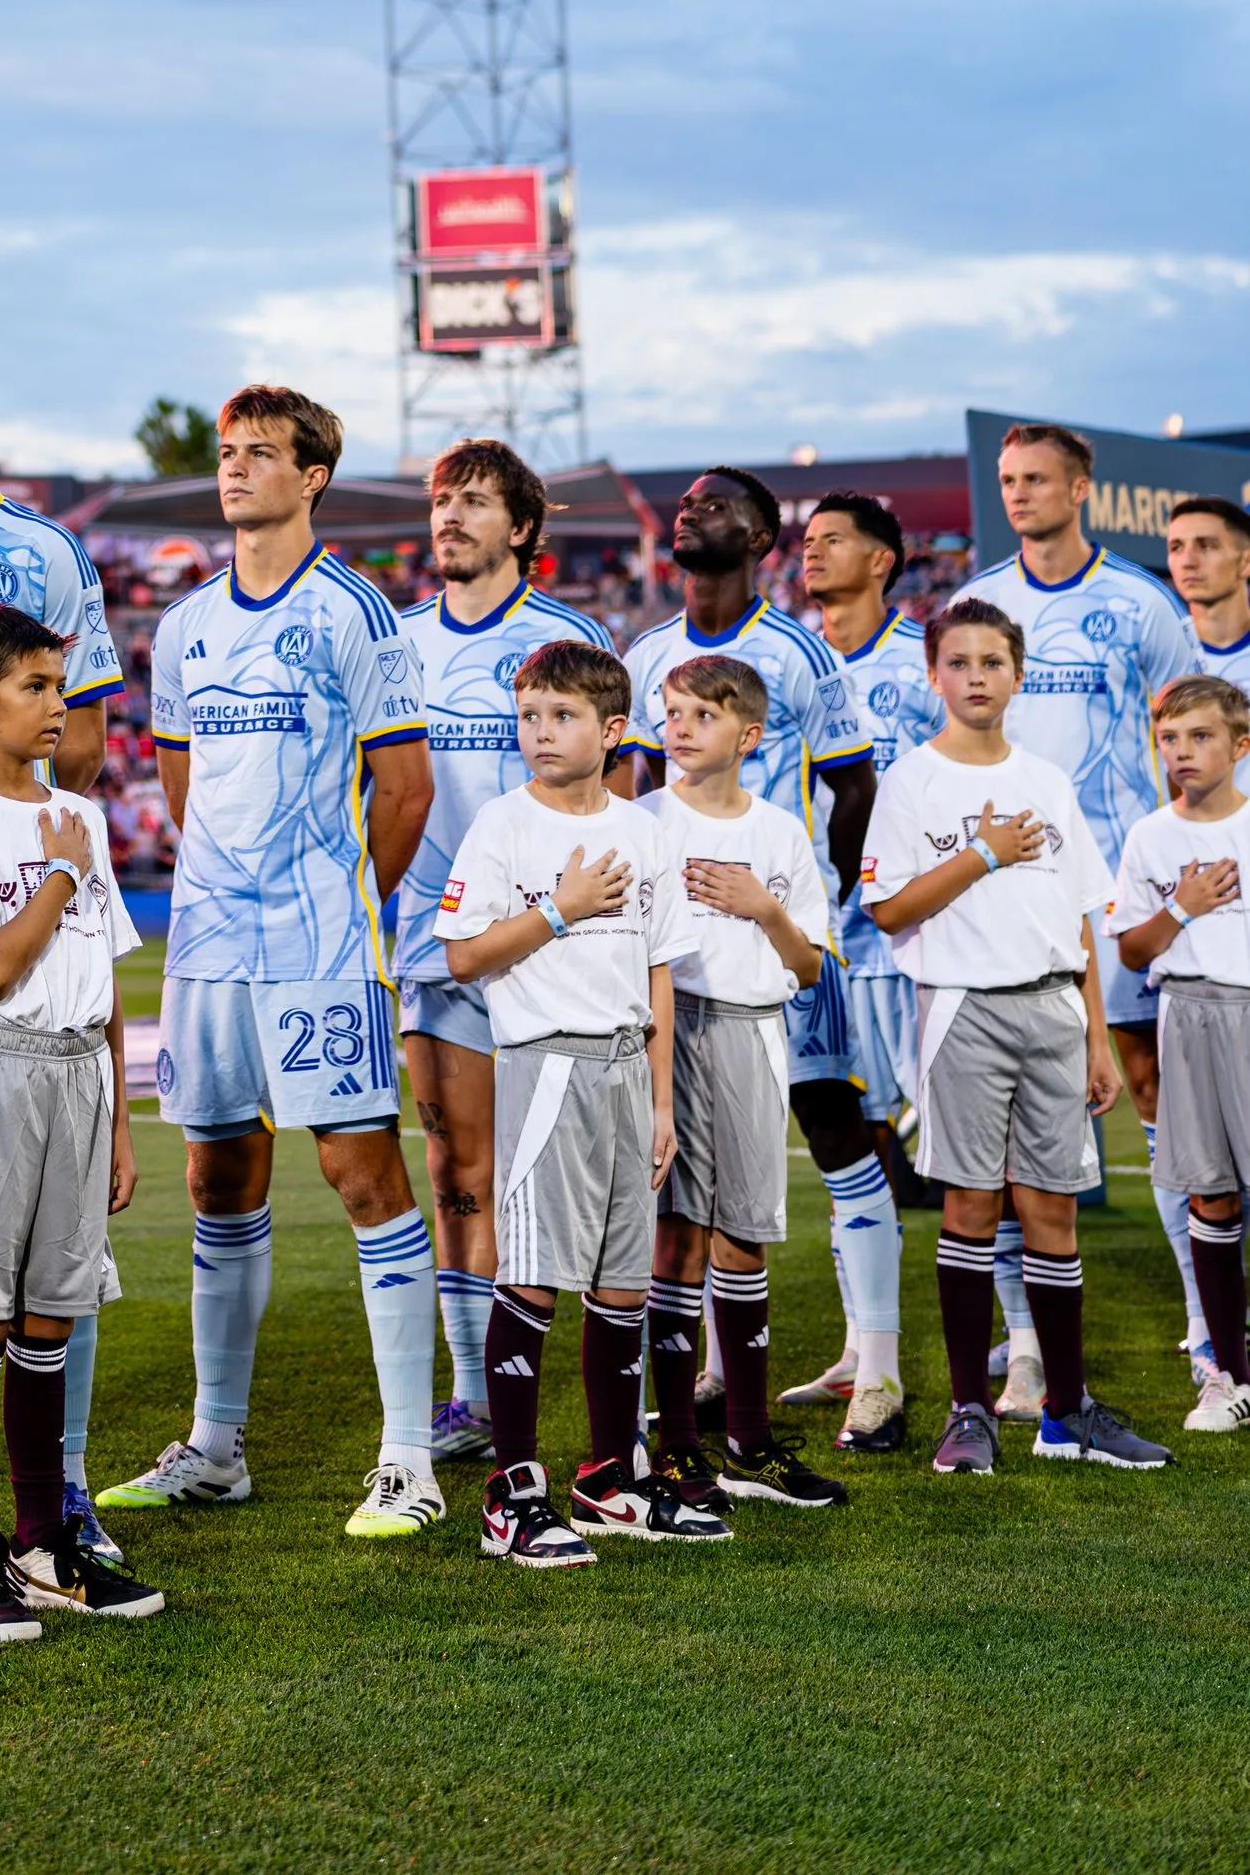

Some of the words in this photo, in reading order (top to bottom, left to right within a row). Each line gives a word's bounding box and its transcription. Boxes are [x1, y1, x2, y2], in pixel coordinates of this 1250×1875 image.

[1088, 480, 1186, 539] MARC
[380, 654, 397, 662] MLS
[253, 702, 306, 717] FAMILY
[400, 695, 419, 714] tv
[841, 717, 859, 735] tv
[279, 1002, 364, 1073] 28
